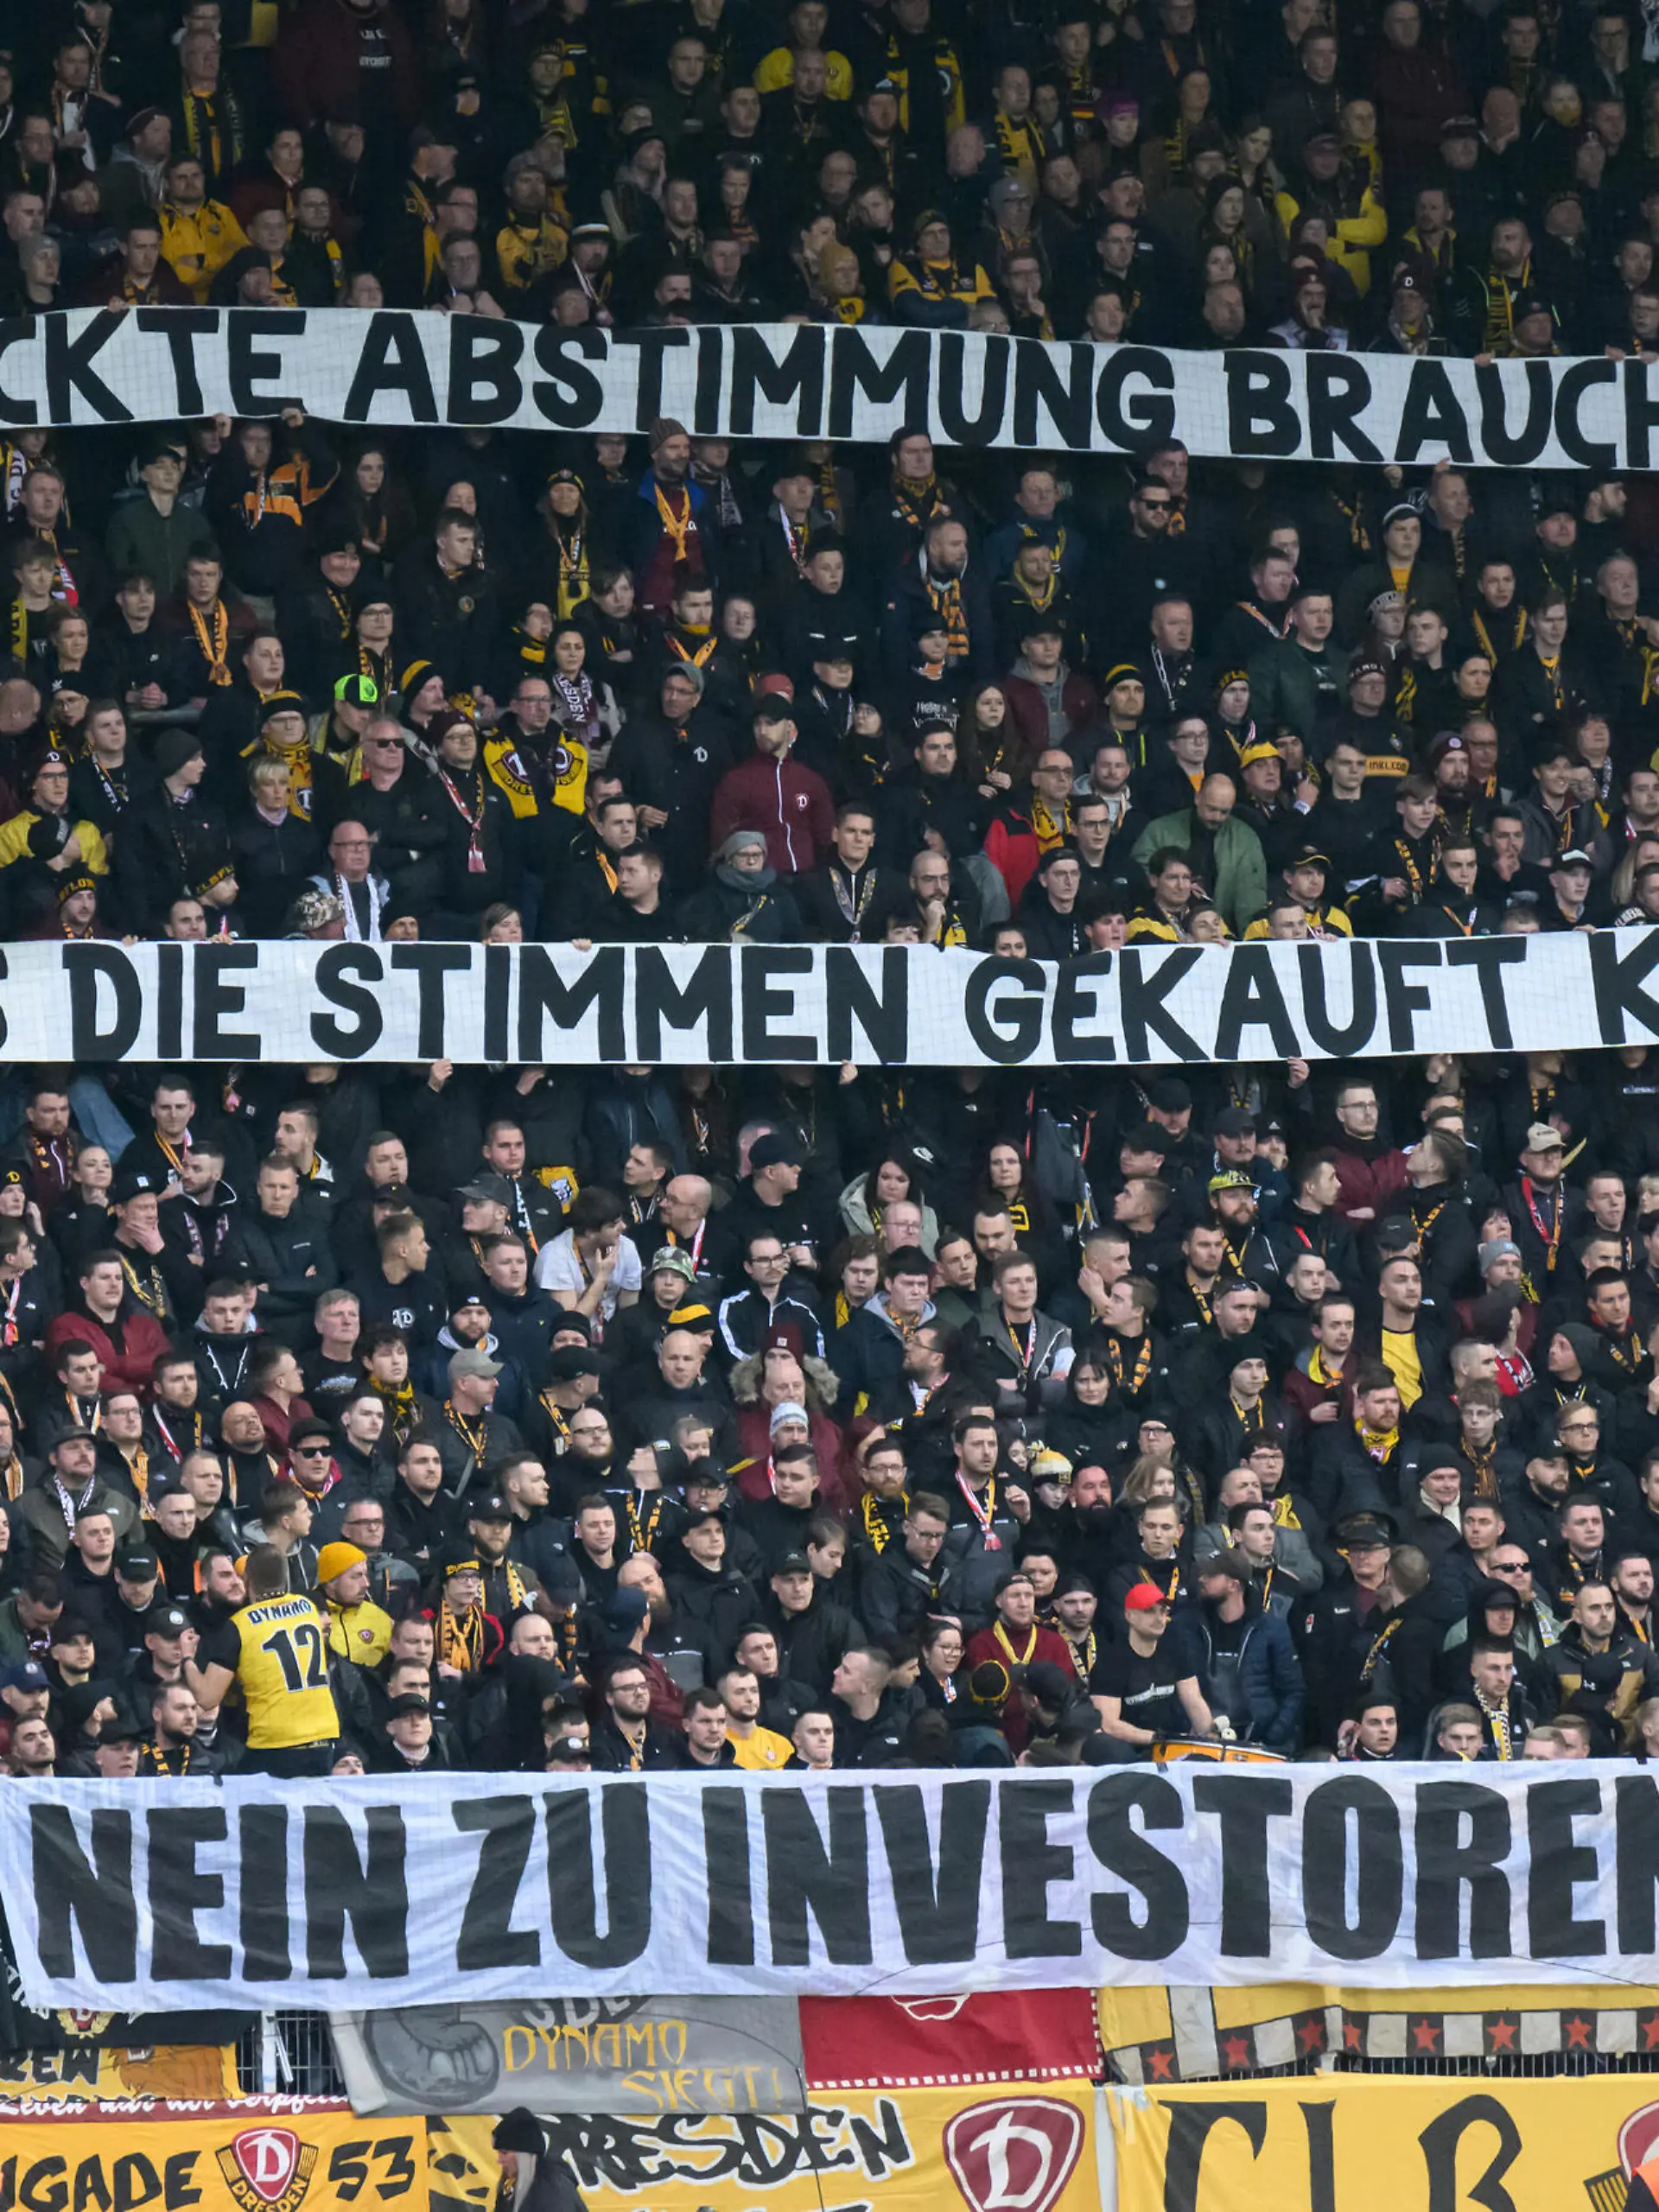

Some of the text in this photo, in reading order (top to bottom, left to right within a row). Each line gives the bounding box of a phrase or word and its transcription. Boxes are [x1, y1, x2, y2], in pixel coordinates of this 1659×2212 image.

[344, 312, 1176, 451] ABSTIMMUNG
[62, 943, 261, 1060] DIE
[310, 943, 909, 1062] STIMMEN
[965, 936, 1527, 1063] GEKAUFT
[1588, 927, 1659, 1045] K
[247, 1599, 312, 1624] DYNAMO
[262, 1624, 328, 1693] 12
[29, 1804, 410, 1984] NEIN
[453, 1783, 652, 1972] ZU
[503, 2020, 688, 2071] DYNAMO
[328, 2135, 416, 2202] 53
[534, 2097, 914, 2195] RESDEN
